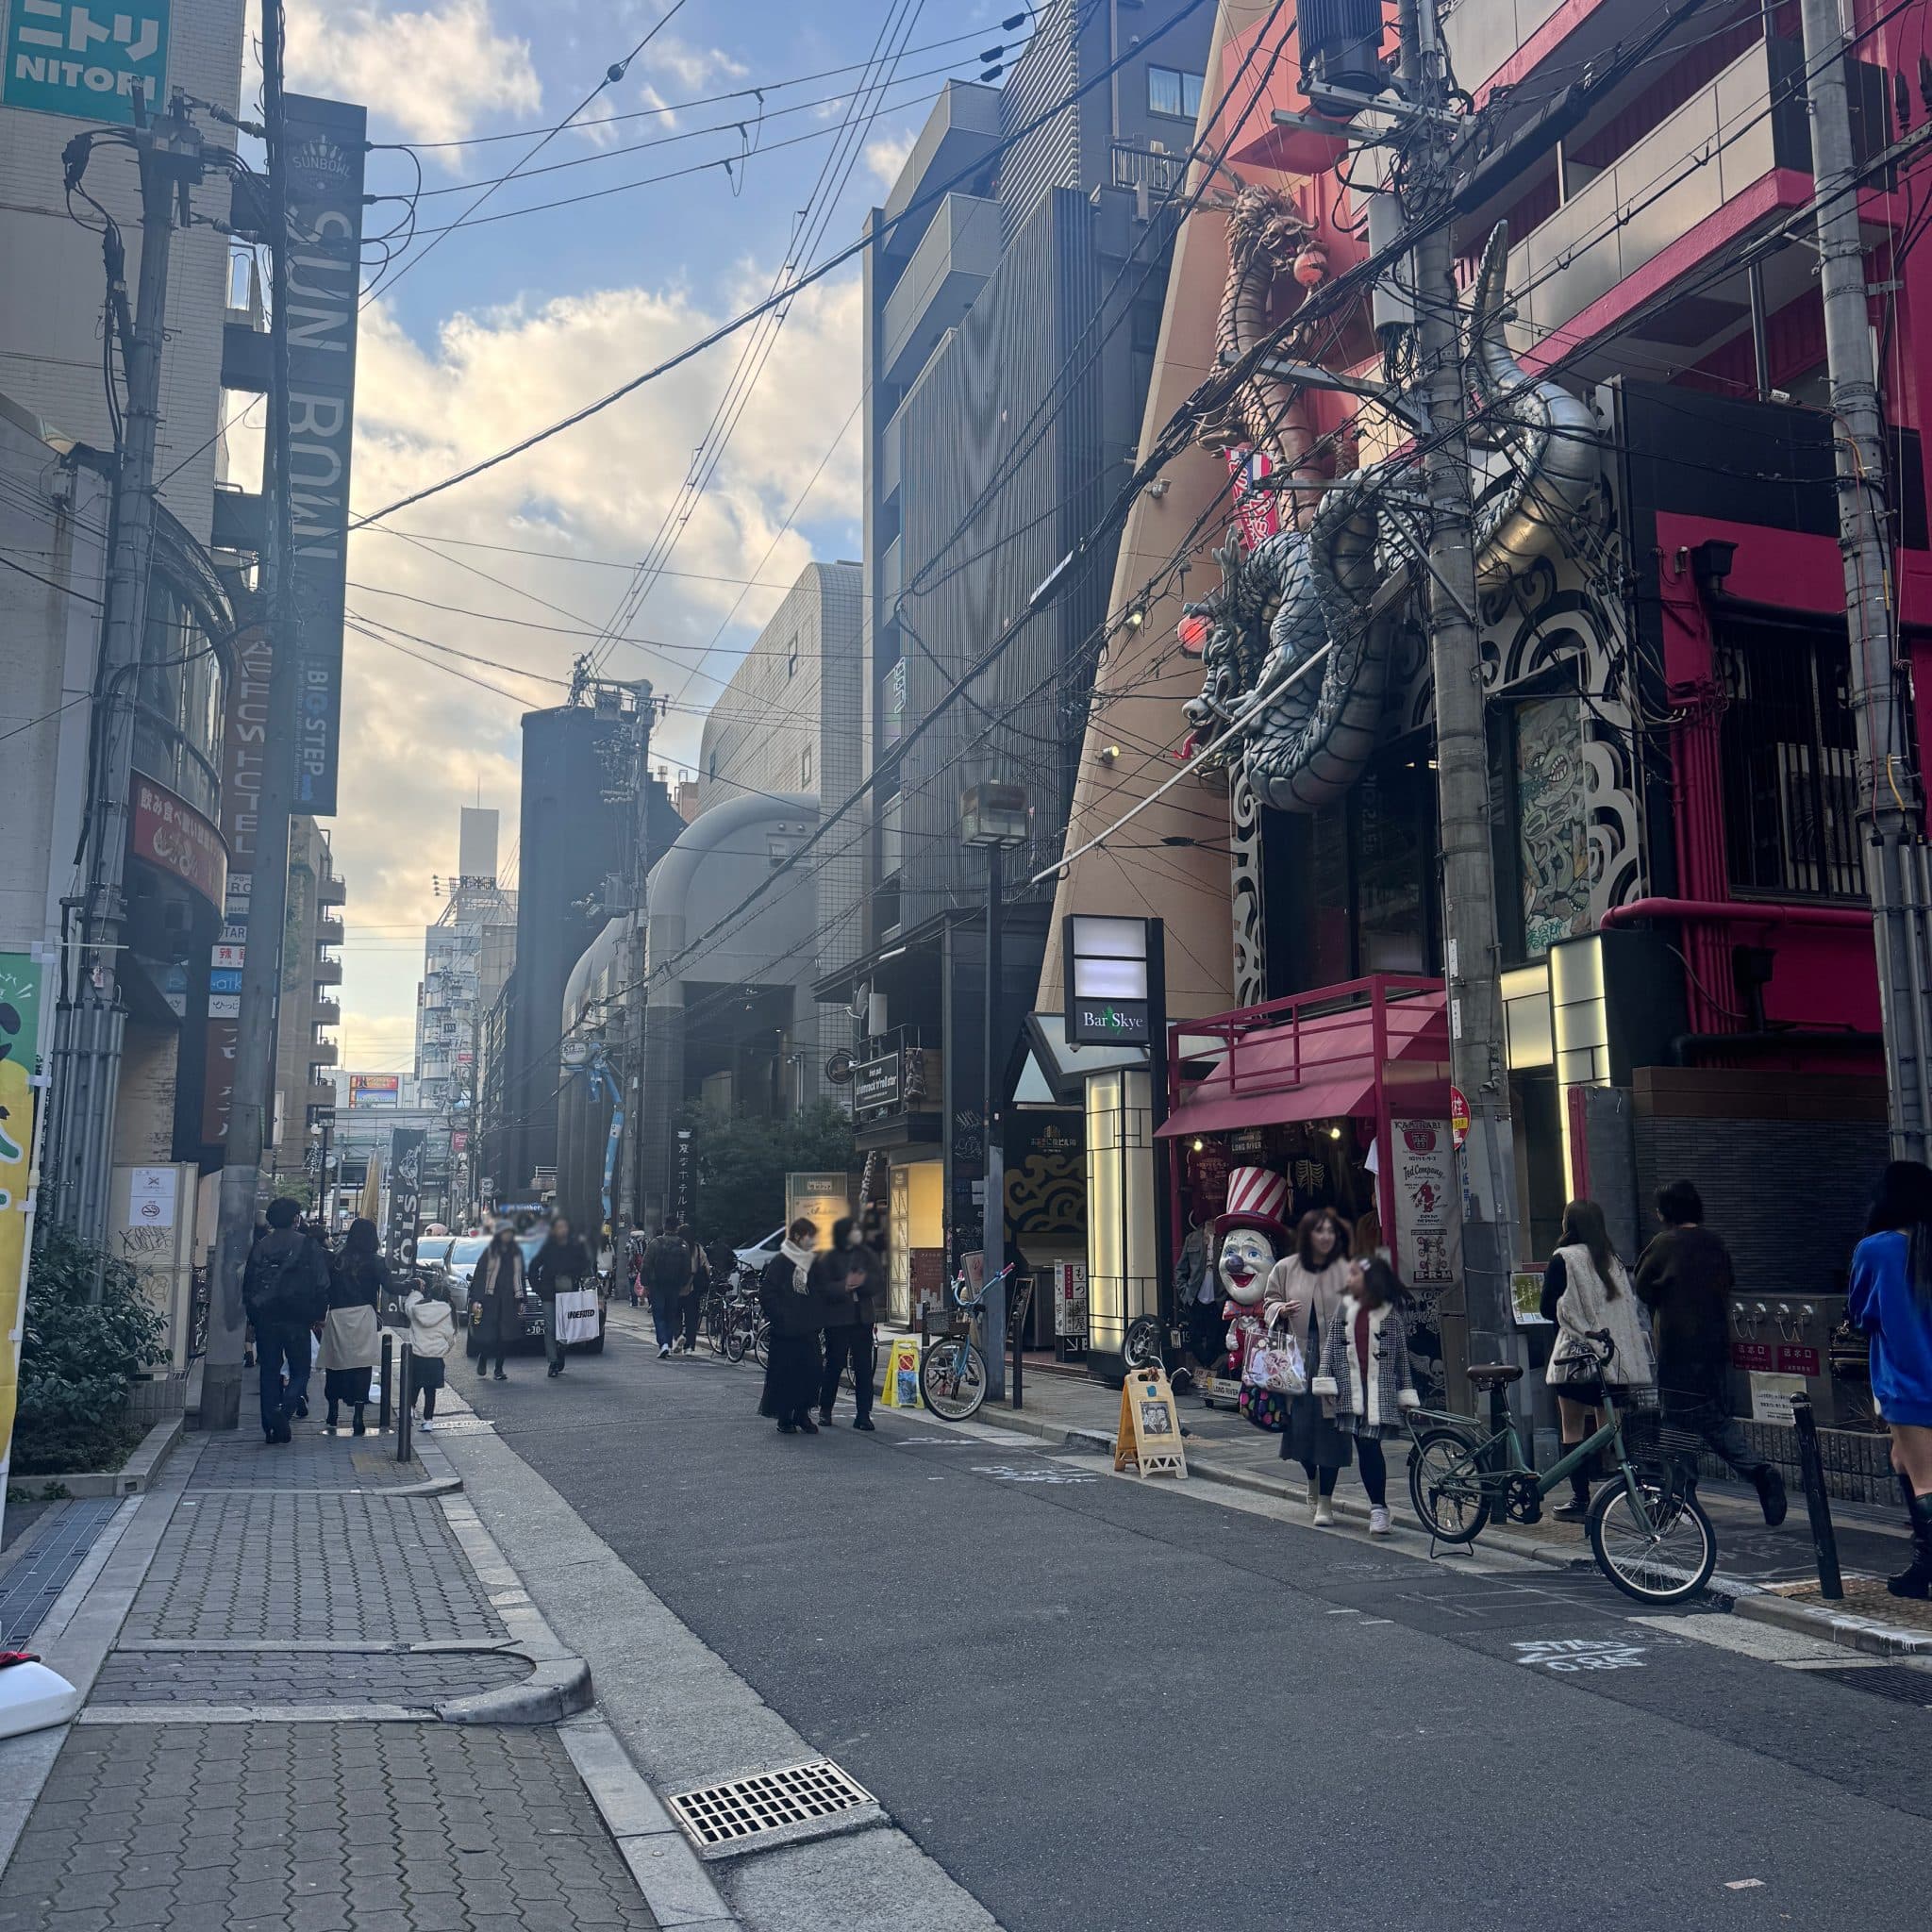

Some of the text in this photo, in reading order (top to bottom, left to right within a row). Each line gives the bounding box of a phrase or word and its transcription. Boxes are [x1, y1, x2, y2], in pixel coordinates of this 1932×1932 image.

[19, 0, 159, 62] ニトリ
[15, 54, 156, 100] NITORI
[293, 156, 352, 179] SUNBOWL
[286, 209, 354, 353] SUN
[304, 717, 326, 776] STEP
[1084, 1011, 1145, 1031] Bar Skye
